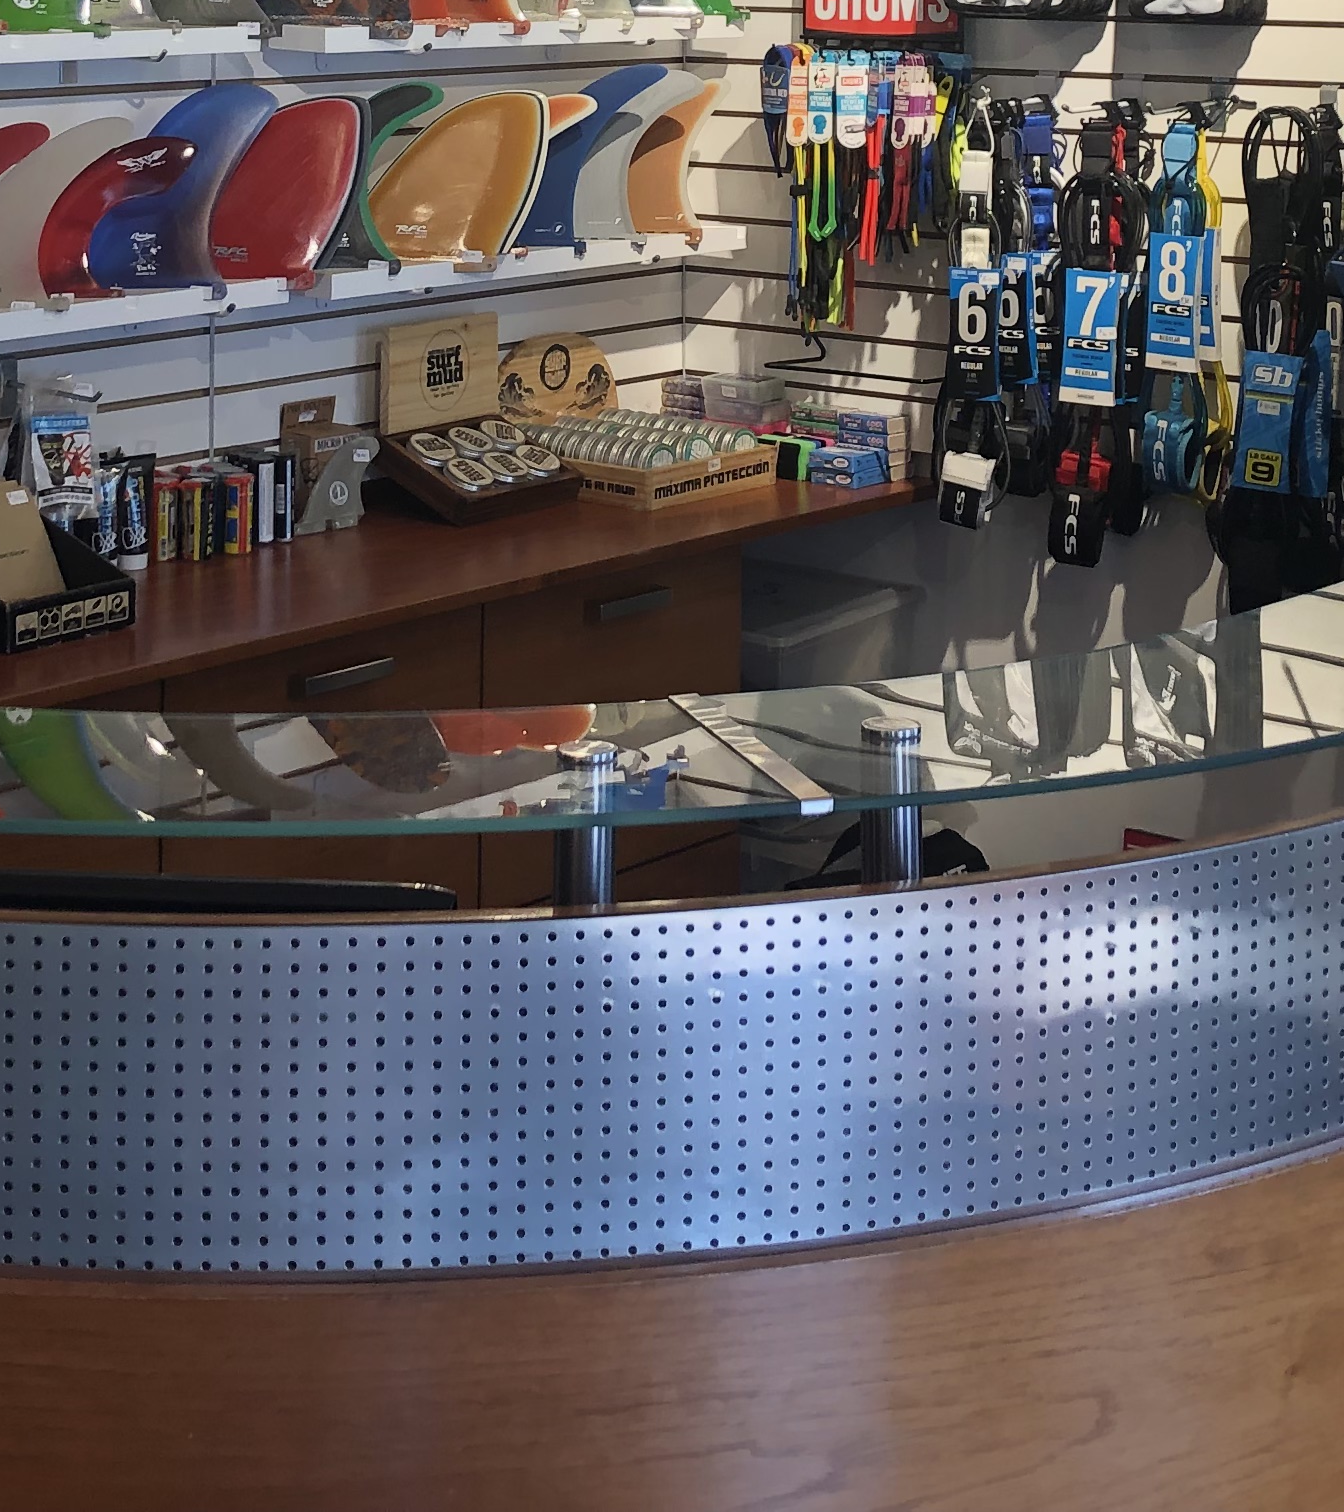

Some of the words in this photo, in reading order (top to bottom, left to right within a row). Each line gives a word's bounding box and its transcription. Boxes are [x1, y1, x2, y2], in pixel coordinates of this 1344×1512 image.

[1090, 199, 1101, 245] FCS
[1152, 303, 1190, 317] FCS
[426, 344, 463, 367] surf
[953, 344, 992, 356] FCS
[1067, 338, 1110, 352] FCS
[427, 364, 465, 388] mud
[1254, 365, 1294, 388] sb
[1152, 419, 1167, 482] FCS
[1250, 461, 1275, 482] 9
[1063, 493, 1081, 556] FCS
